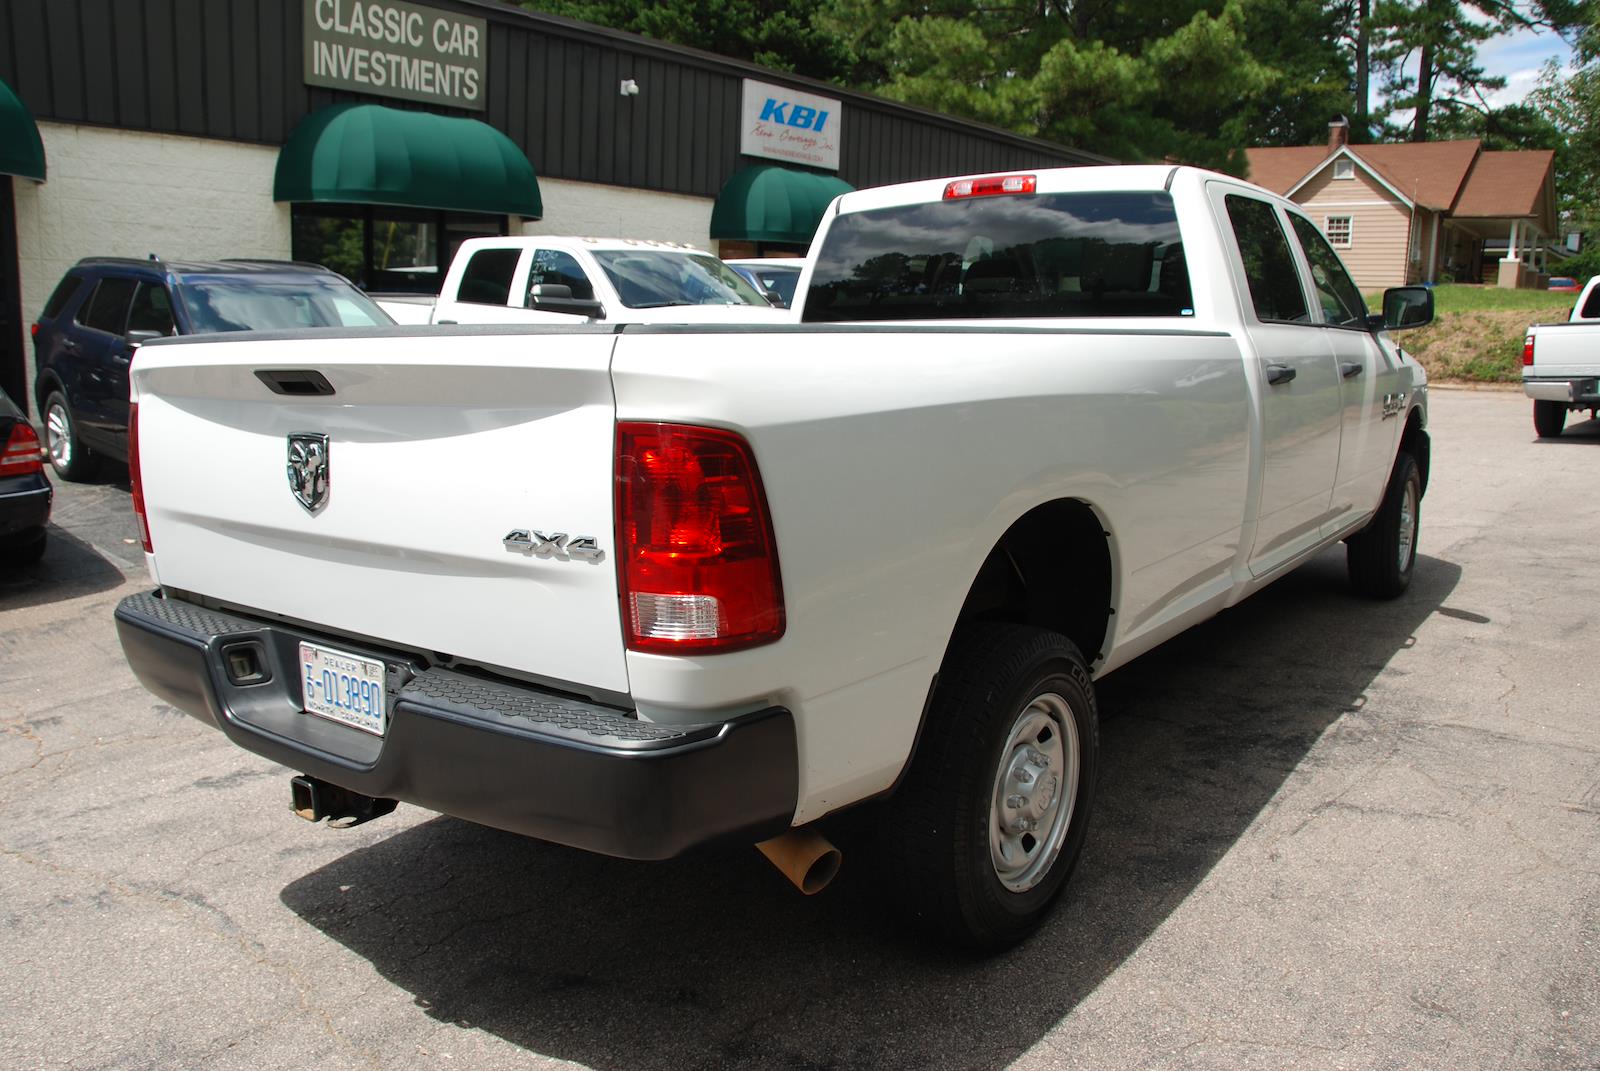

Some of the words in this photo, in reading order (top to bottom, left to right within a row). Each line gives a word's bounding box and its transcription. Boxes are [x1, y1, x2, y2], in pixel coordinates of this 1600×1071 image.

[315, 0, 424, 47] CLASSIC
[432, 18, 480, 58] CAR
[313, 40, 480, 100] INVESTMENTS
[759, 98, 829, 133] KBI
[324, 656, 357, 673] DEALER
